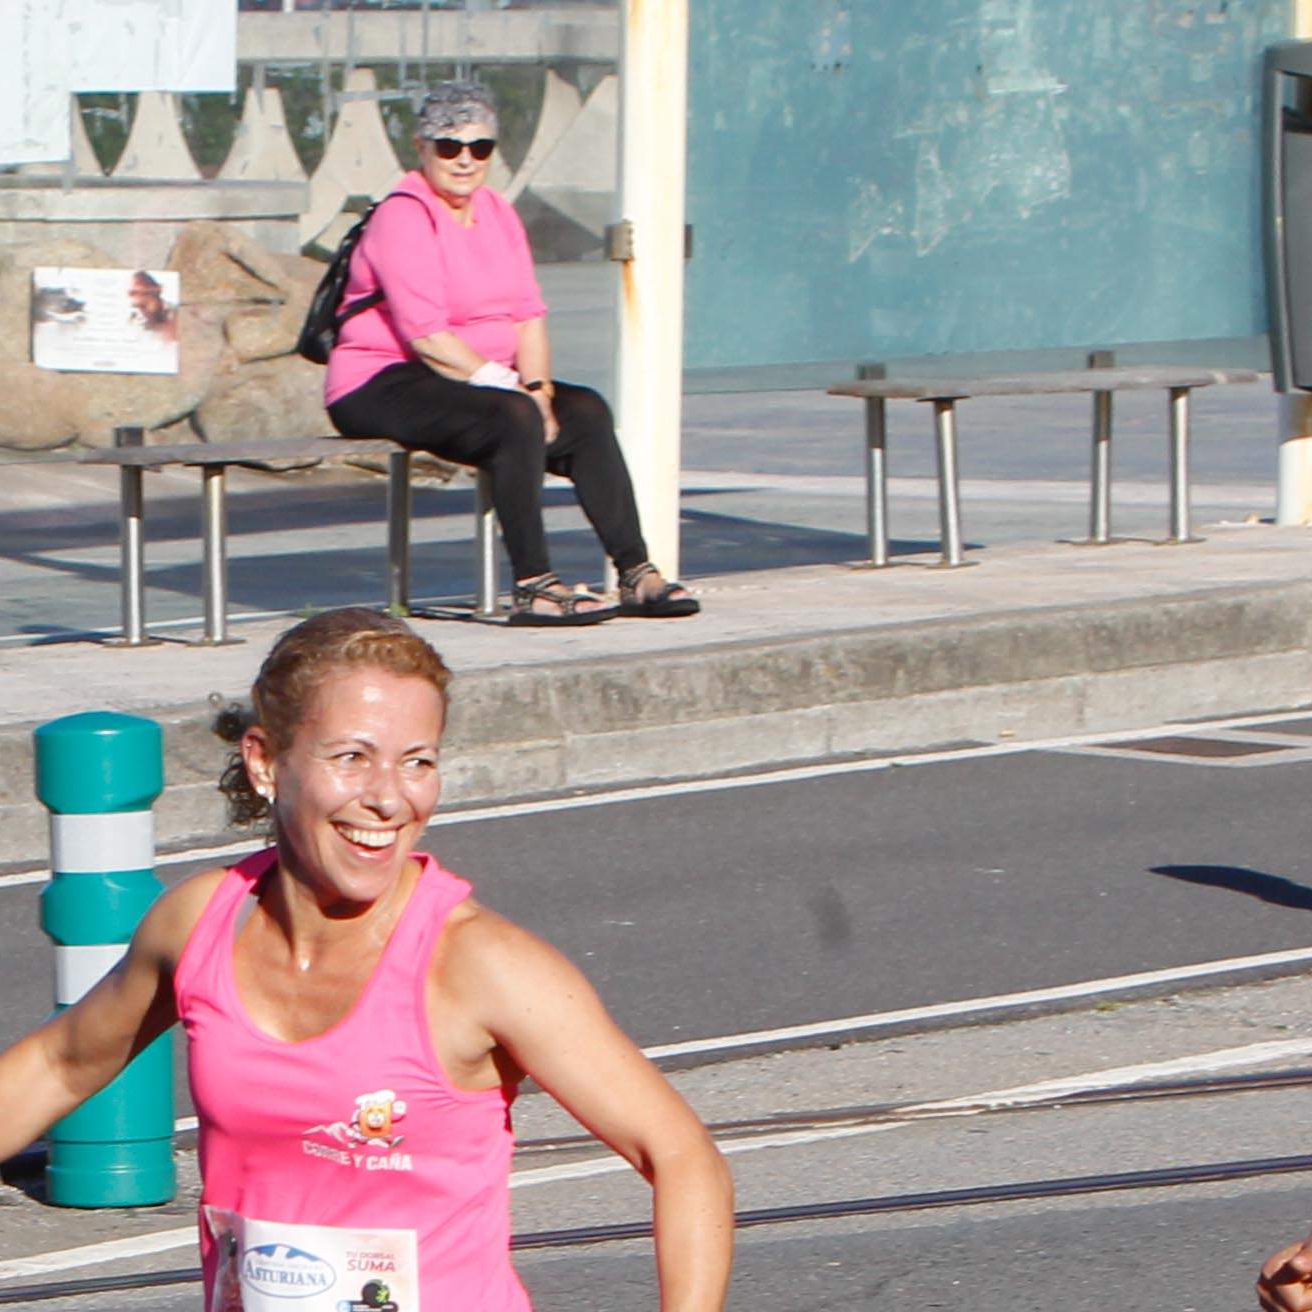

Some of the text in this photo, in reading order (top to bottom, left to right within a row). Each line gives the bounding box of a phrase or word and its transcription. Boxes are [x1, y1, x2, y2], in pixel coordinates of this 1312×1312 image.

[353, 1154, 364, 1168] Y
[366, 1153, 413, 1171] CAÑA
[346, 1259, 396, 1273] SUMA
